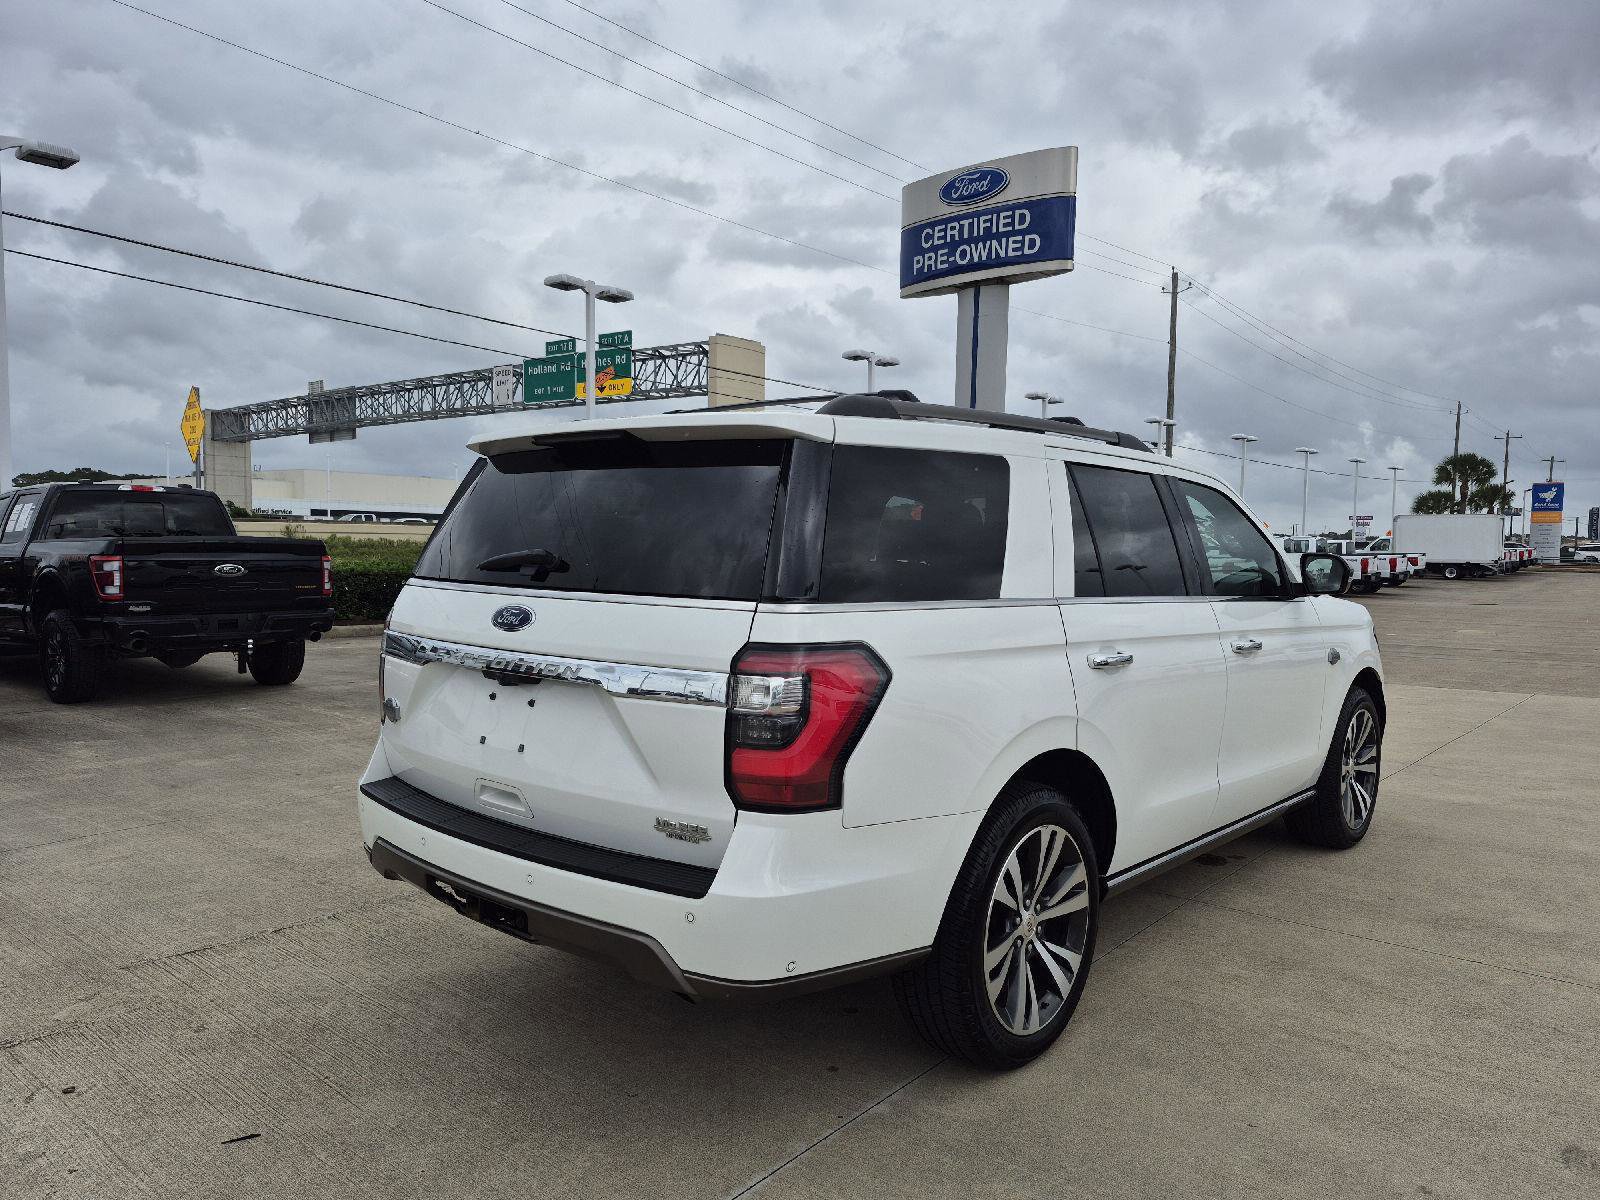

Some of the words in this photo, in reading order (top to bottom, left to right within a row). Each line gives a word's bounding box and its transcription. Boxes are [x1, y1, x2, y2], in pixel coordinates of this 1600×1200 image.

[951, 172, 991, 199] Ford
[921, 208, 1031, 249] CERTIFIED
[913, 234, 1041, 275] PRE-OWNED
[614, 334, 622, 345] 17
[623, 333, 630, 344] A
[615, 353, 626, 365] Rd
[494, 369, 511, 377] SPEED
[528, 363, 557, 376] Holland
[560, 361, 571, 372] Rd
[608, 383, 625, 391] ONLY
[498, 609, 524, 625] Ford
